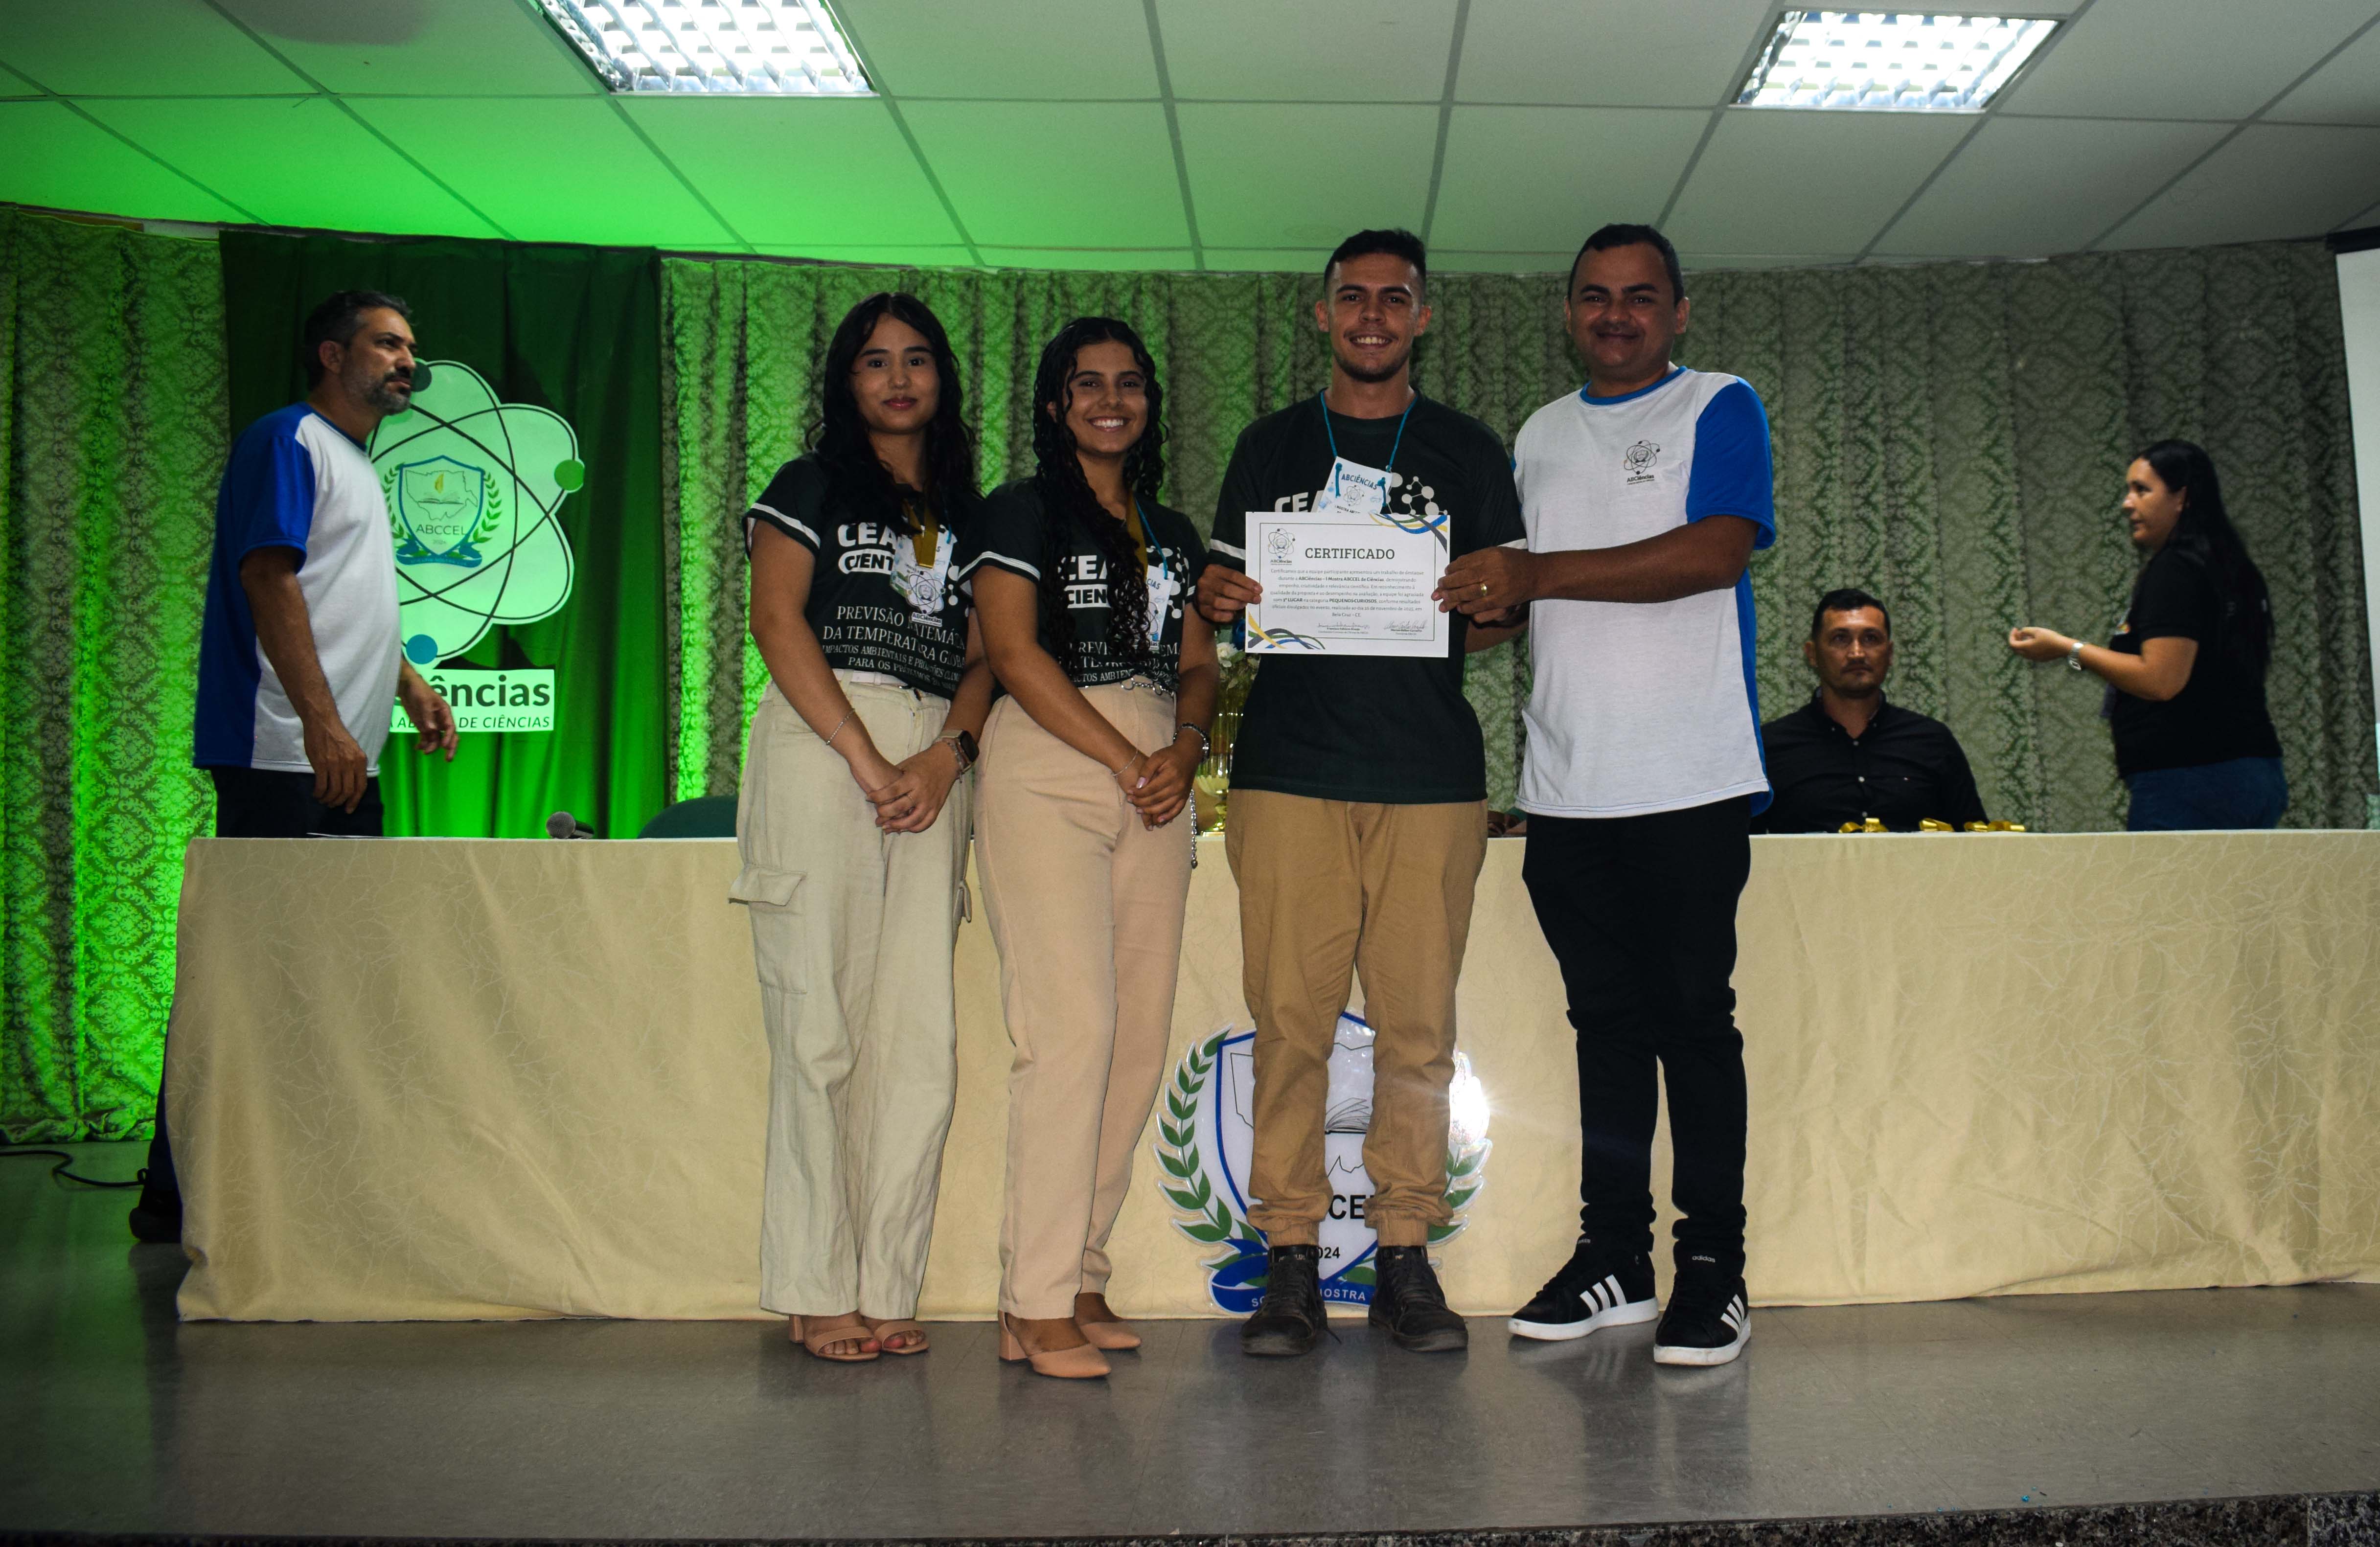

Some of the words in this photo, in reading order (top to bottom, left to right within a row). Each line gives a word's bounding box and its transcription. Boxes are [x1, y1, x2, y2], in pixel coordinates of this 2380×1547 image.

[1341, 474, 1378, 490] ABCIÊNCIAS
[1626, 474, 1655, 482] ABCiências
[416, 524, 466, 535] ABCCEL
[838, 522, 896, 550] CEA
[1305, 547, 1395, 559] CERTIFICADO
[1146, 578, 1161, 590] CIAS
[837, 606, 904, 627] PREVISÃO
[912, 613, 941, 623] ABCiências
[823, 626, 842, 640] DA
[847, 626, 936, 660] TEMPERATURA
[822, 644, 859, 655] IMPACTOS
[861, 645, 907, 663] AMBIENTAIS
[908, 656, 914, 666] E
[848, 657, 875, 668] PARA
[878, 660, 891, 670] OS
[429, 675, 550, 707] ências
[458, 717, 478, 728] DE
[483, 714, 550, 728] CIÊNCIAS
[1320, 1288, 1366, 1301] OSTRA
